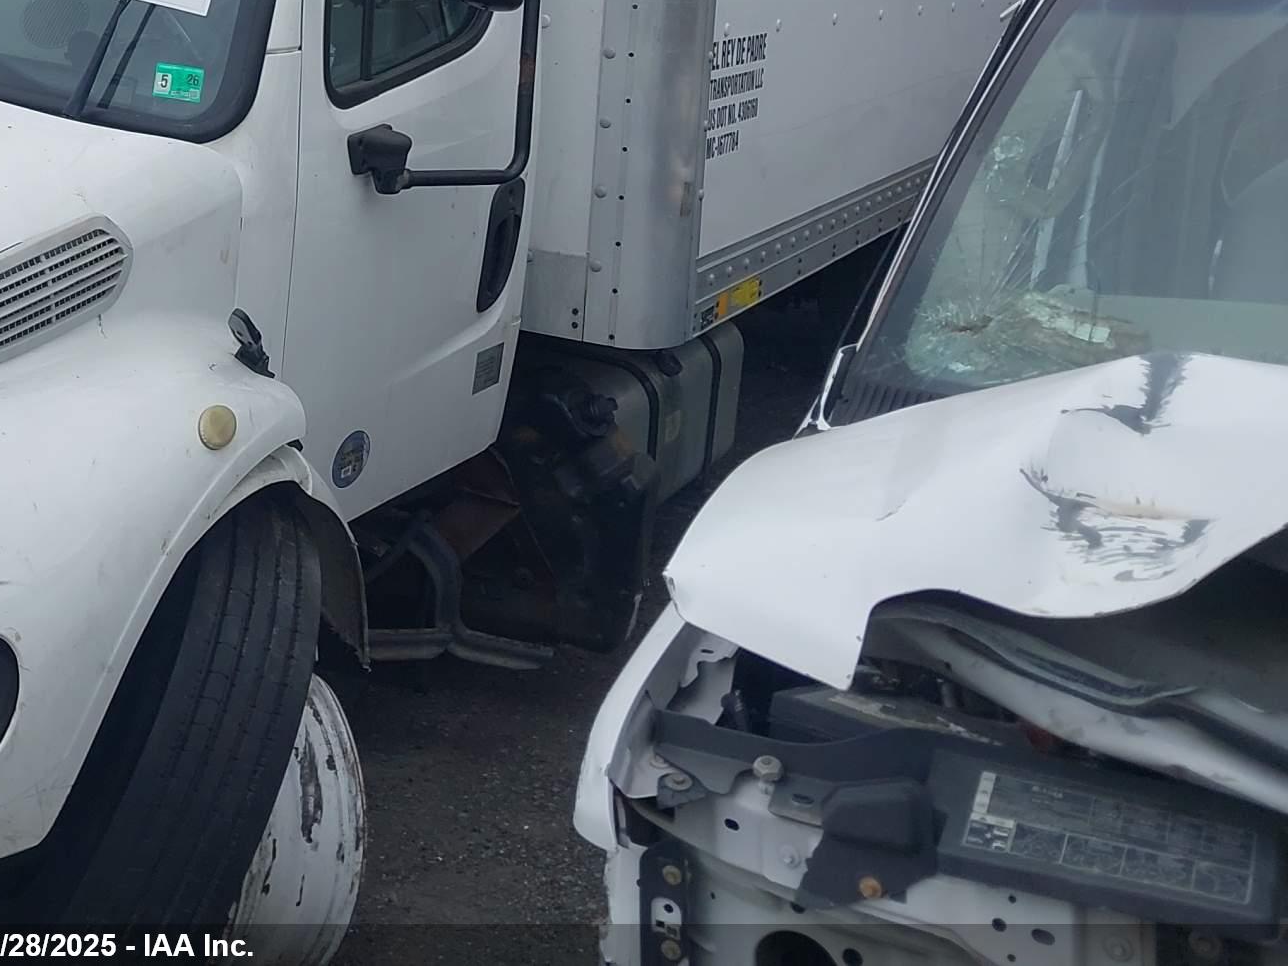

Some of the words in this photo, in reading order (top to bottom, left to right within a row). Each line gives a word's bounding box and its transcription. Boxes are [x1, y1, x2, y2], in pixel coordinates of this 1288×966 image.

[712, 42, 720, 70] EL
[721, 38, 736, 69] REY
[736, 36, 746, 66] DE
[746, 32, 768, 63] PADRE
[160, 74, 169, 88] 5
[187, 73, 200, 87] 26
[710, 70, 755, 100] TRANSPORTATION
[755, 67, 764, 90] LLC
[716, 105, 728, 130] DOT
